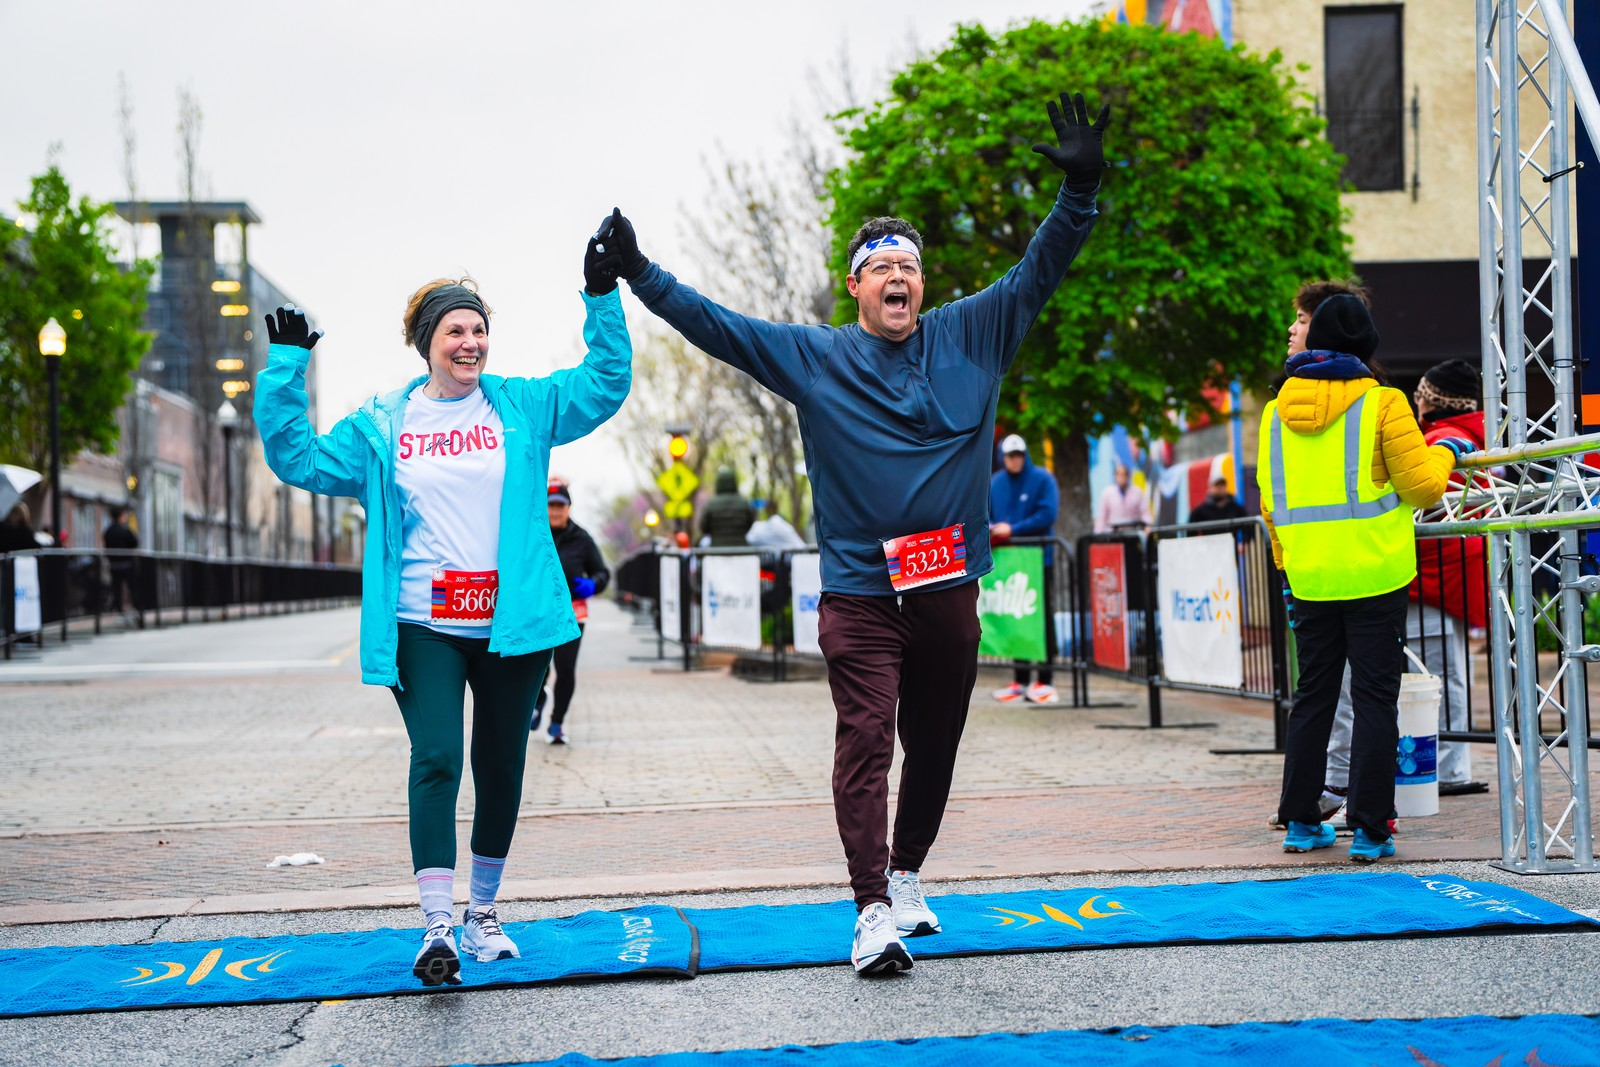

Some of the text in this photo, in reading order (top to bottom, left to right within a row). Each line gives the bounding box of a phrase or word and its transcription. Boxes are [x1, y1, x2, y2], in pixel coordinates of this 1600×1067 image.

[399, 425, 498, 460] STRONG
[906, 546, 950, 577] 5323
[452, 587, 499, 612] 5666
[1172, 590, 1213, 622] Walmart
